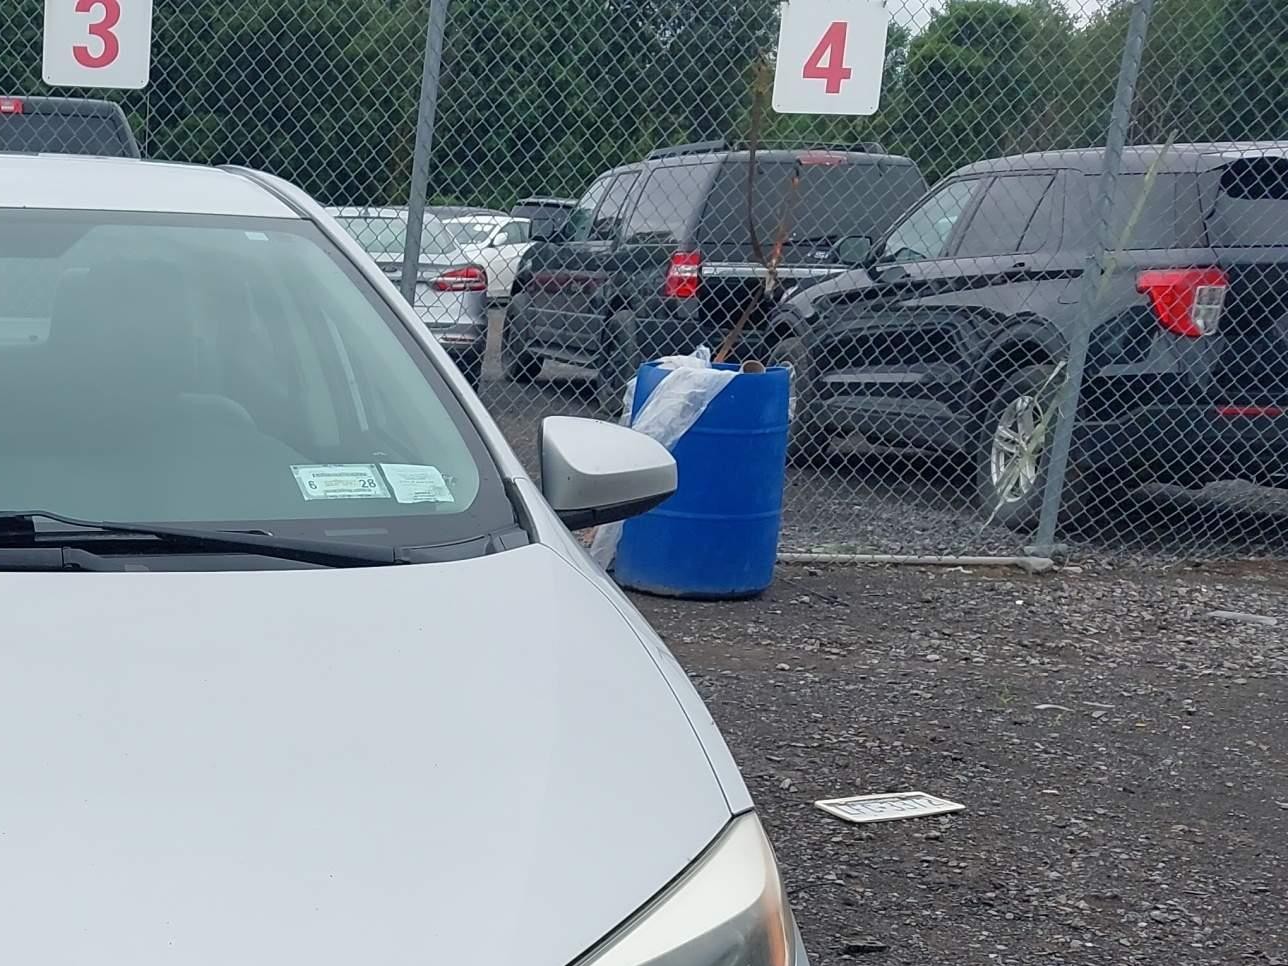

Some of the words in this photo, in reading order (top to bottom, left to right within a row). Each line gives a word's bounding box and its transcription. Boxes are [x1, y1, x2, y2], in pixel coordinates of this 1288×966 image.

[72, 0, 121, 69] 3
[802, 21, 852, 94] 4
[359, 478, 377, 489] 28
